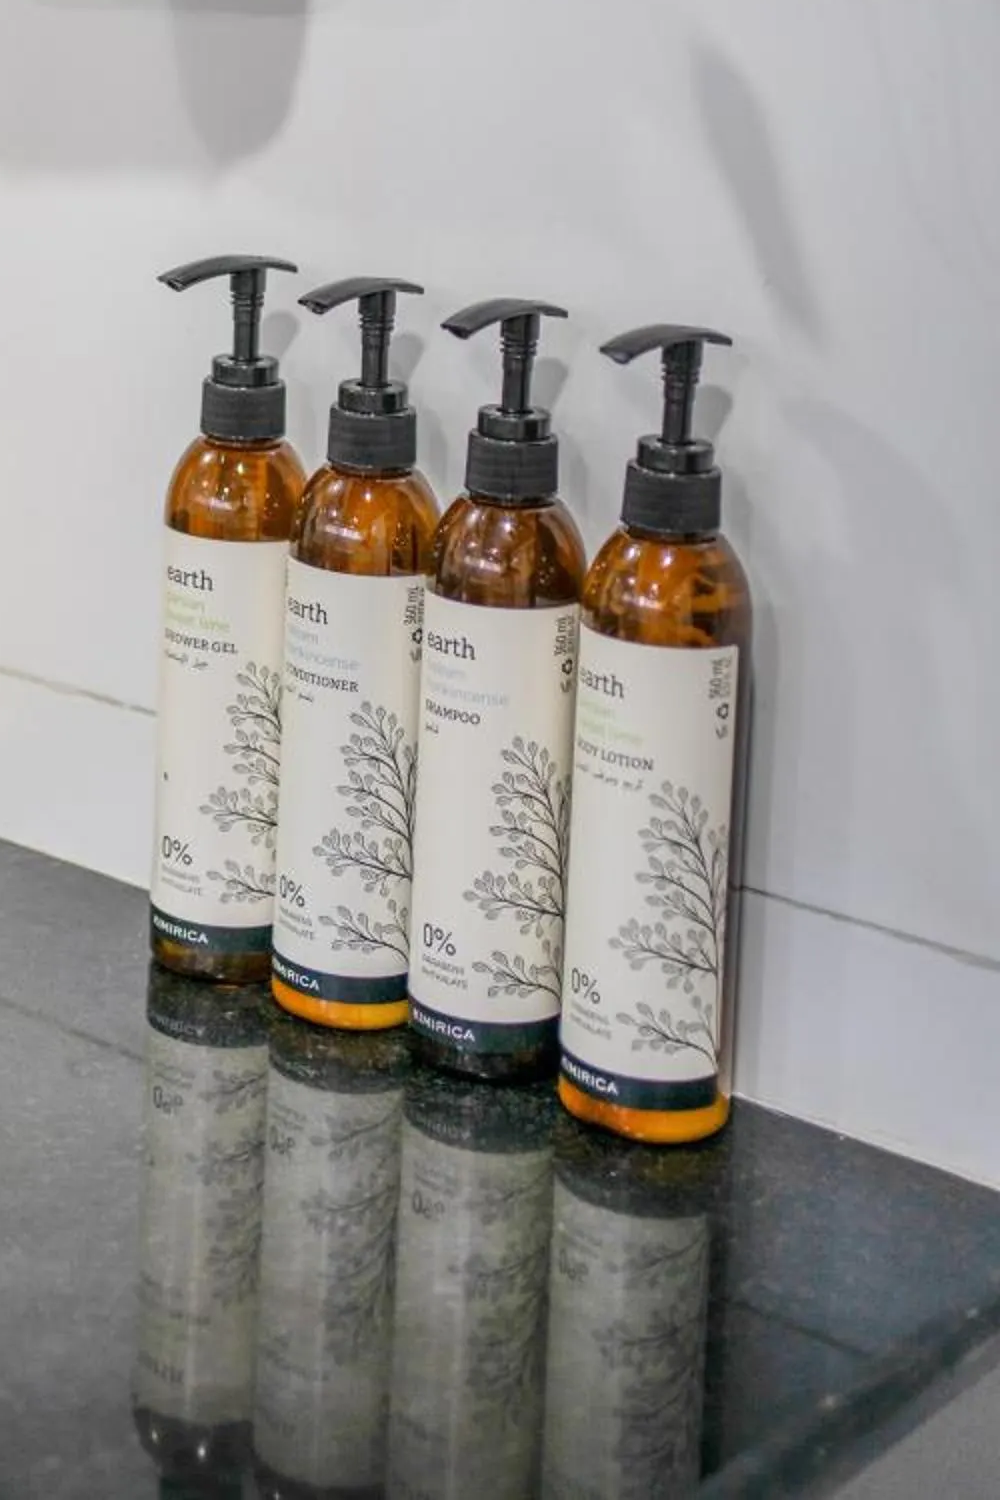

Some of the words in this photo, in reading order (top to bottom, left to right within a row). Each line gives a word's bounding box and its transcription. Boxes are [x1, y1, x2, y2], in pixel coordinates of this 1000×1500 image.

[167, 565, 213, 592] earth
[287, 596, 329, 625] earth
[211, 640, 239, 654] GEL
[427, 631, 476, 660] earth
[579, 666, 624, 698] earth
[601, 750, 655, 771] LOTION
[162, 835, 193, 866] 0%
[279, 874, 306, 908] 0%
[423, 923, 457, 956] 0%
[571, 967, 601, 1005] 0%
